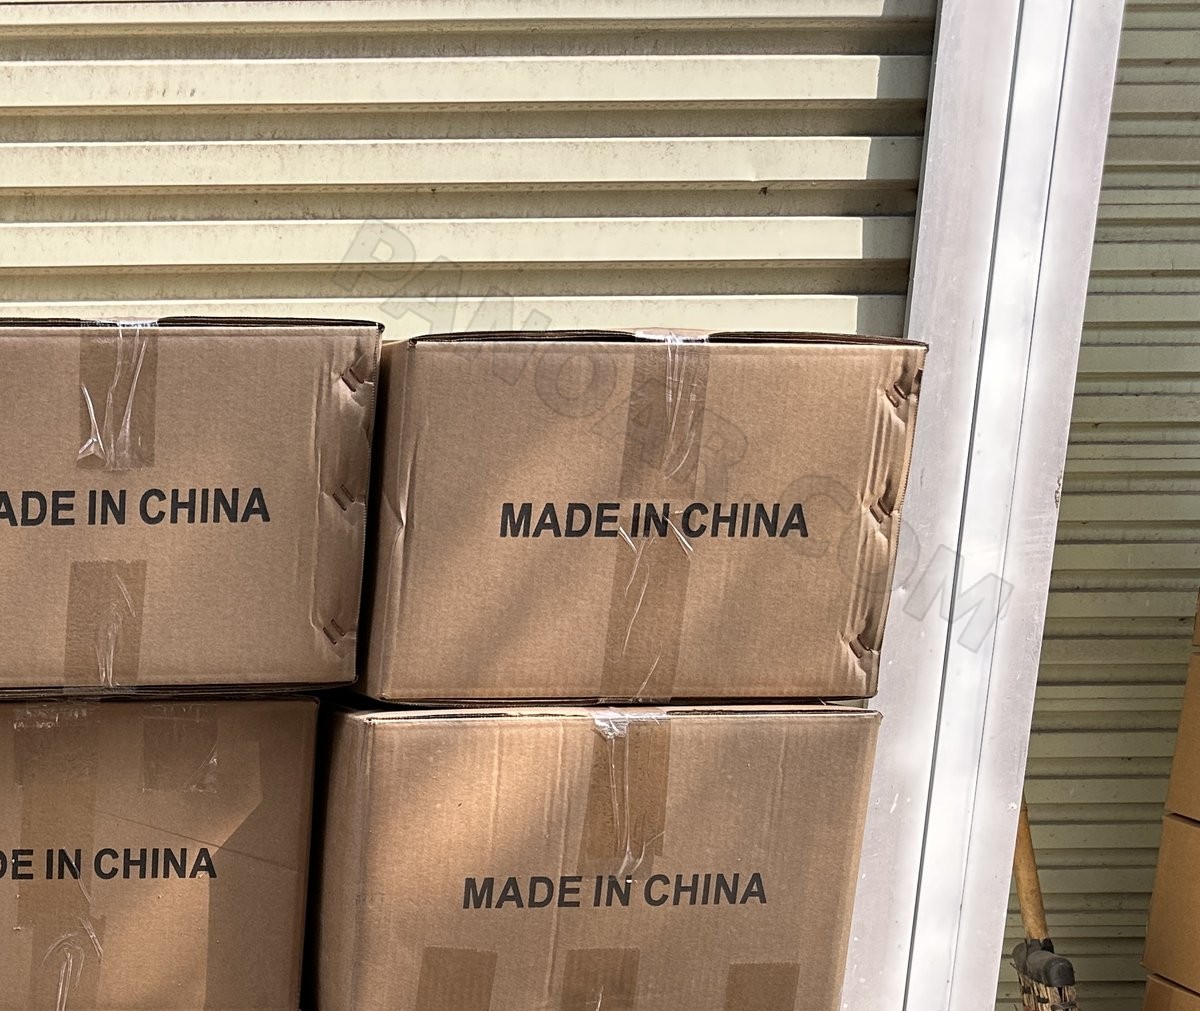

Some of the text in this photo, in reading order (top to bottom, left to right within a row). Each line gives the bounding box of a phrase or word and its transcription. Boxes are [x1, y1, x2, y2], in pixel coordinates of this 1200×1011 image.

[88, 490, 126, 525] IN
[140, 488, 270, 524] CHINA
[500, 503, 808, 538] MADE IN CHINA
[46, 849, 81, 879] IN
[94, 848, 217, 879] CHINA
[463, 873, 766, 909] MADE IN CHINA
